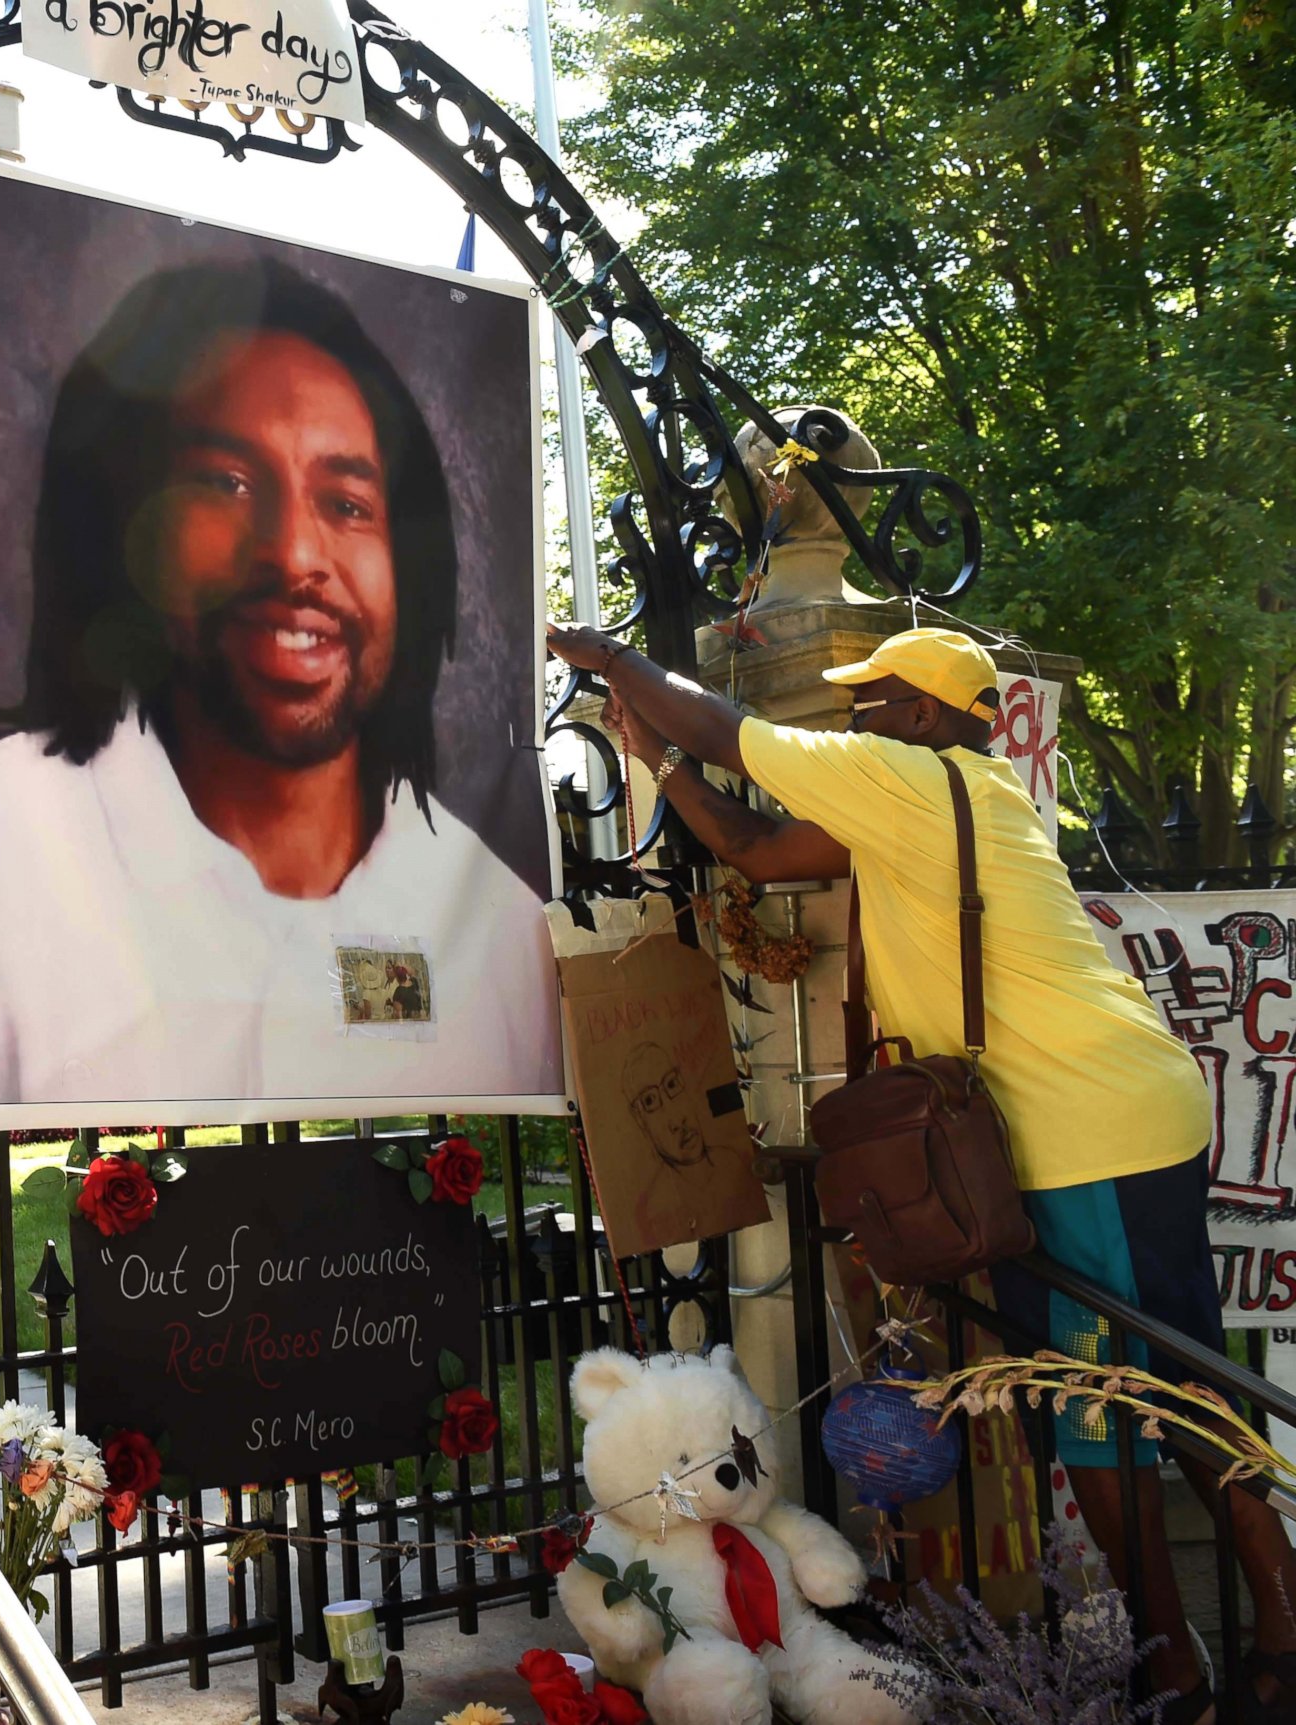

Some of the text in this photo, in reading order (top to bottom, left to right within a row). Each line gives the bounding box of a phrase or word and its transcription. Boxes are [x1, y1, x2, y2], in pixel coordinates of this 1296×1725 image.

[89, 0, 251, 78] brighter
[261, 11, 352, 105] day
[246, 83, 297, 107] Shakur
[198, 1224, 250, 1318] of
[258, 1255, 310, 1287] our
[320, 1232, 432, 1277] wounds,
[164, 1321, 233, 1394] Red
[240, 1312, 323, 1389] Roses
[294, 1409, 355, 1451] Mero
